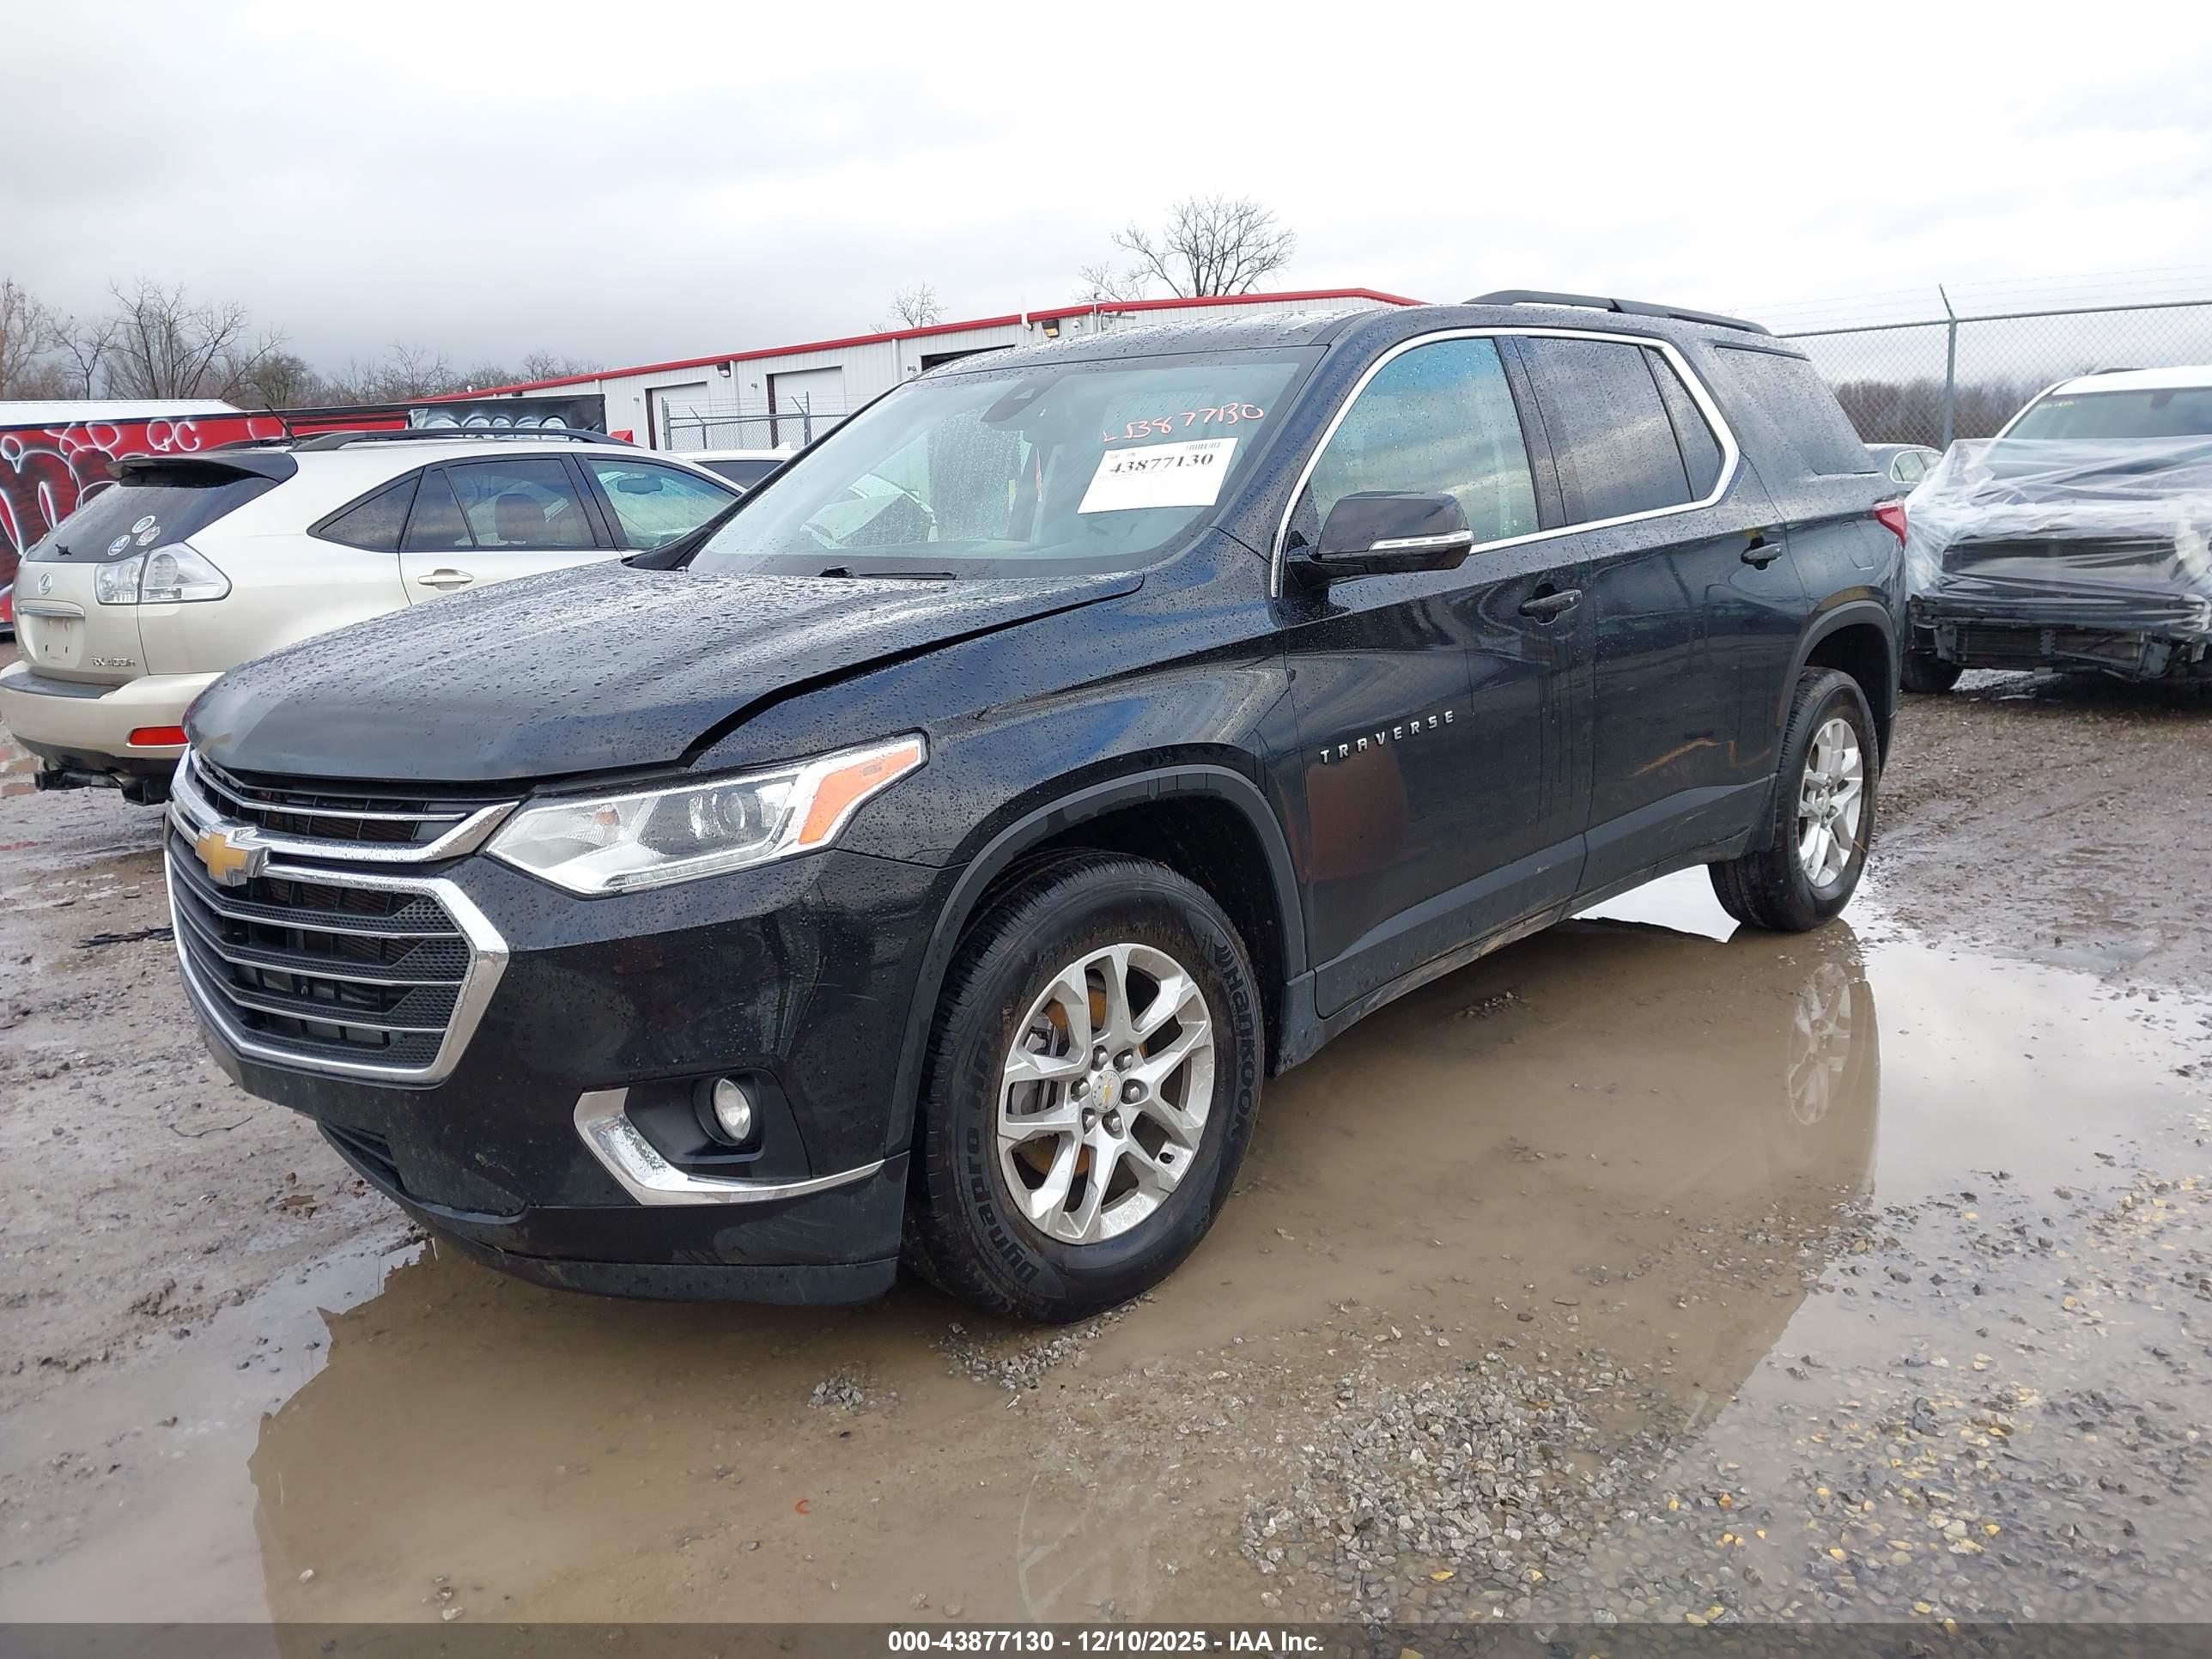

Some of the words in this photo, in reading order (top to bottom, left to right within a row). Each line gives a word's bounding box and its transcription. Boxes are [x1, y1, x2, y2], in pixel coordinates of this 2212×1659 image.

[1109, 453, 1214, 473] 43877130
[89, 656, 106, 666] RX
[1320, 710, 1454, 763] TRAVERSE
